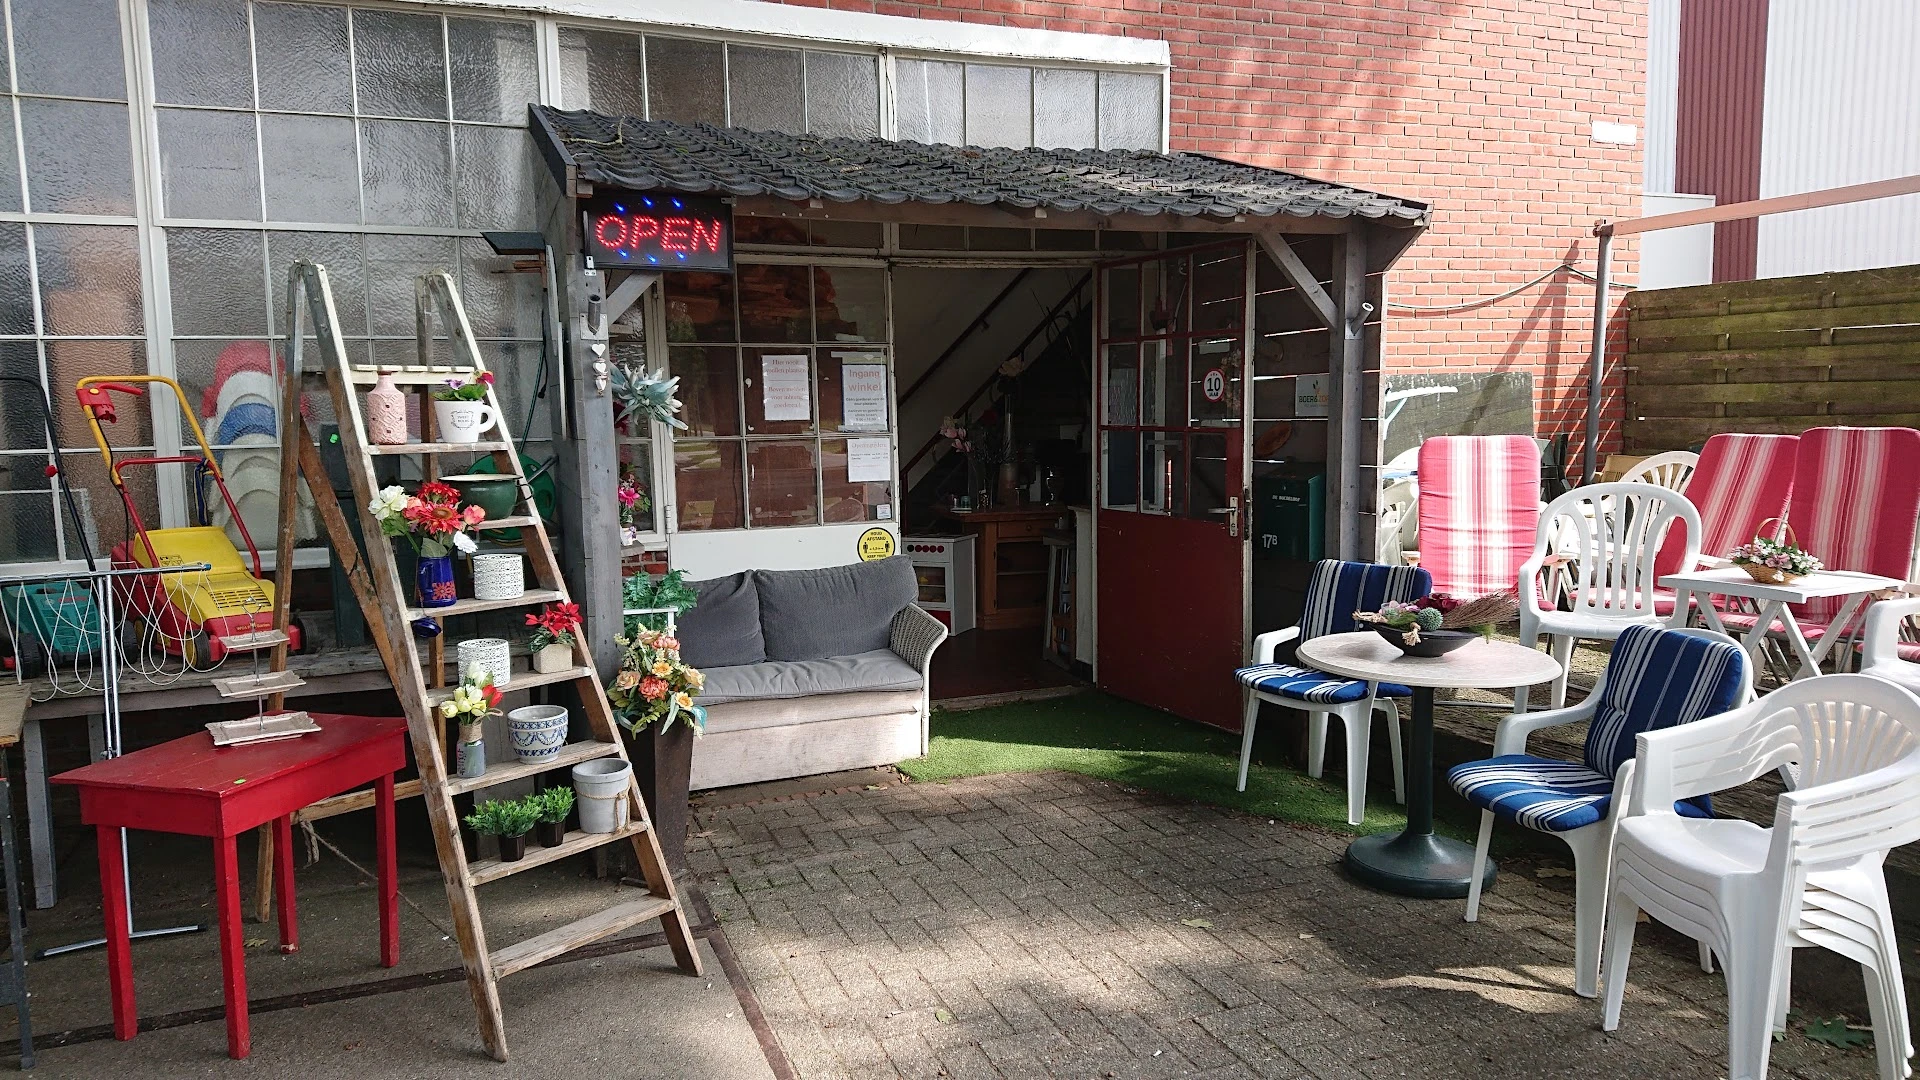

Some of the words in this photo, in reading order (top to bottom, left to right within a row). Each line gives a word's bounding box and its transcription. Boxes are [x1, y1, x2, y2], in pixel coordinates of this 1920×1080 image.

[595, 213, 722, 253] OPEN
[849, 369, 880, 380] Ingang
[848, 382, 882, 392] winkel
[1207, 377, 1221, 392] 10
[1261, 533, 1278, 549] 17B
